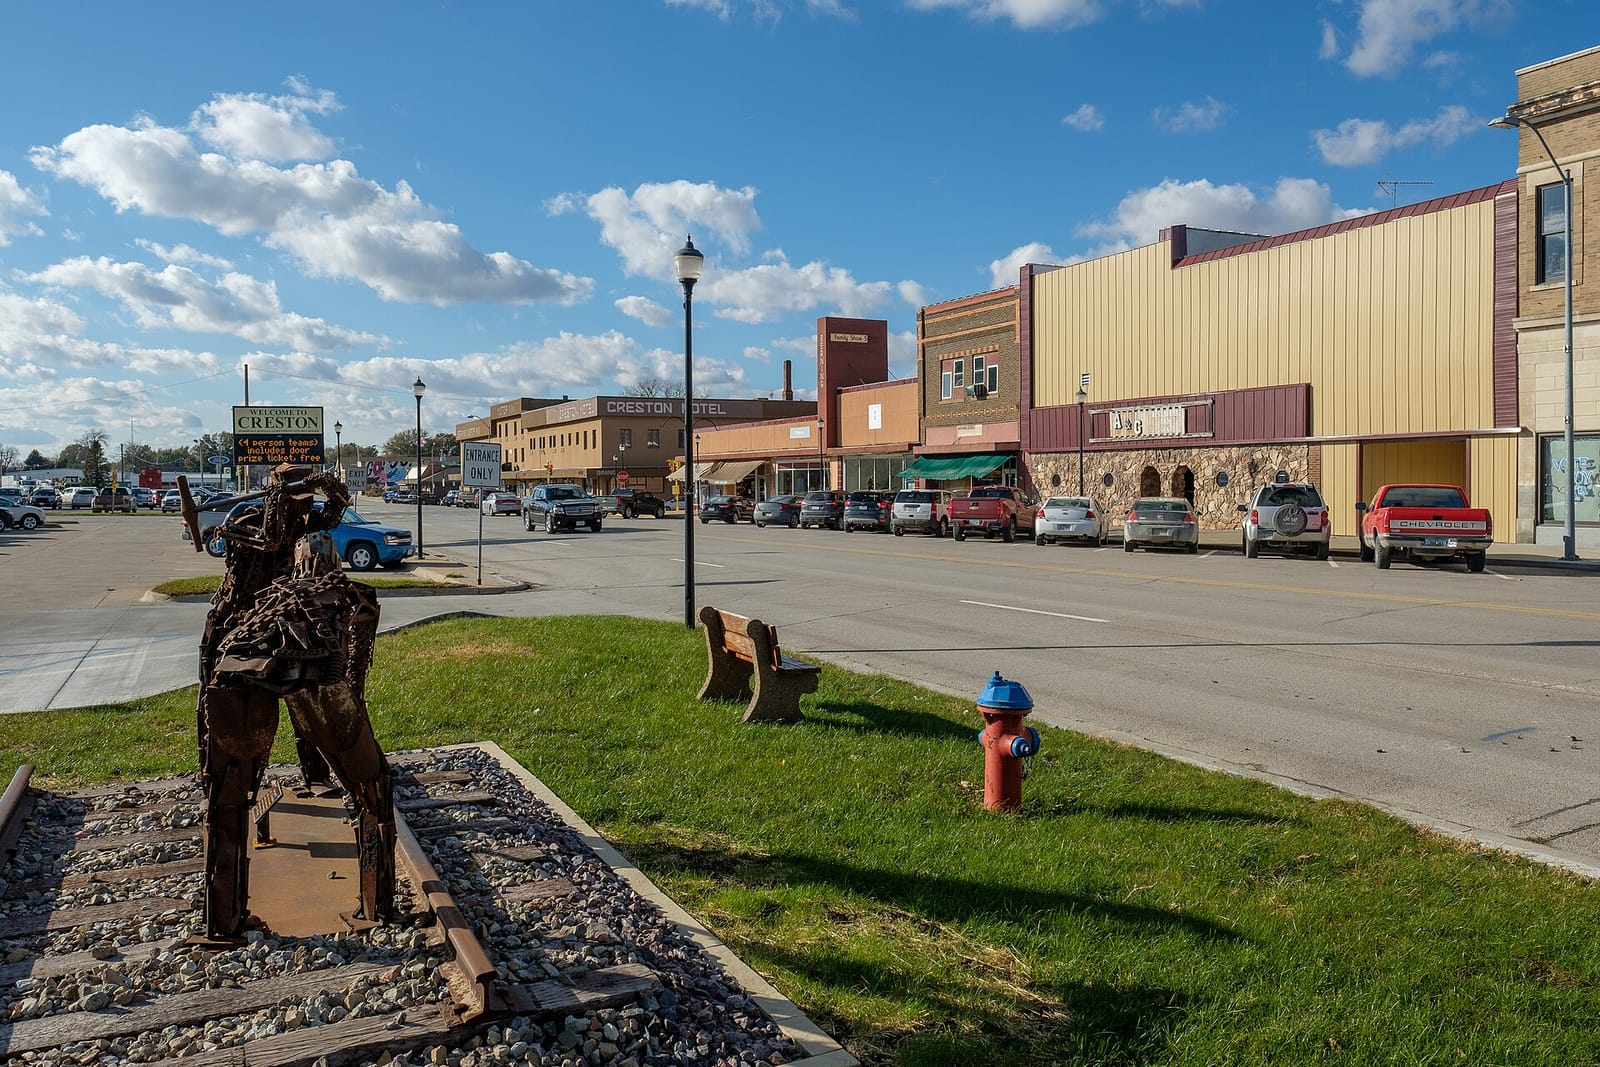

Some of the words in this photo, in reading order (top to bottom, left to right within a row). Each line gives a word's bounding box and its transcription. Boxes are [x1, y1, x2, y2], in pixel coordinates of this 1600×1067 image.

[607, 401, 672, 414] CRESTON
[237, 416, 318, 429] CRESTON
[1114, 412, 1123, 430] A
[1125, 418, 1133, 430] &
[252, 439, 285, 448] person
[247, 447, 286, 455] includes
[289, 446, 311, 455] door
[465, 448, 500, 463] ENTRANCE
[237, 454, 264, 463] prize
[300, 454, 321, 463] free
[1551, 456, 1591, 471] VOE
[349, 470, 365, 478] EXIT
[470, 466, 494, 481] ONLY
[347, 480, 366, 488] ONLY
[1400, 521, 1477, 529] CHEVROLET
